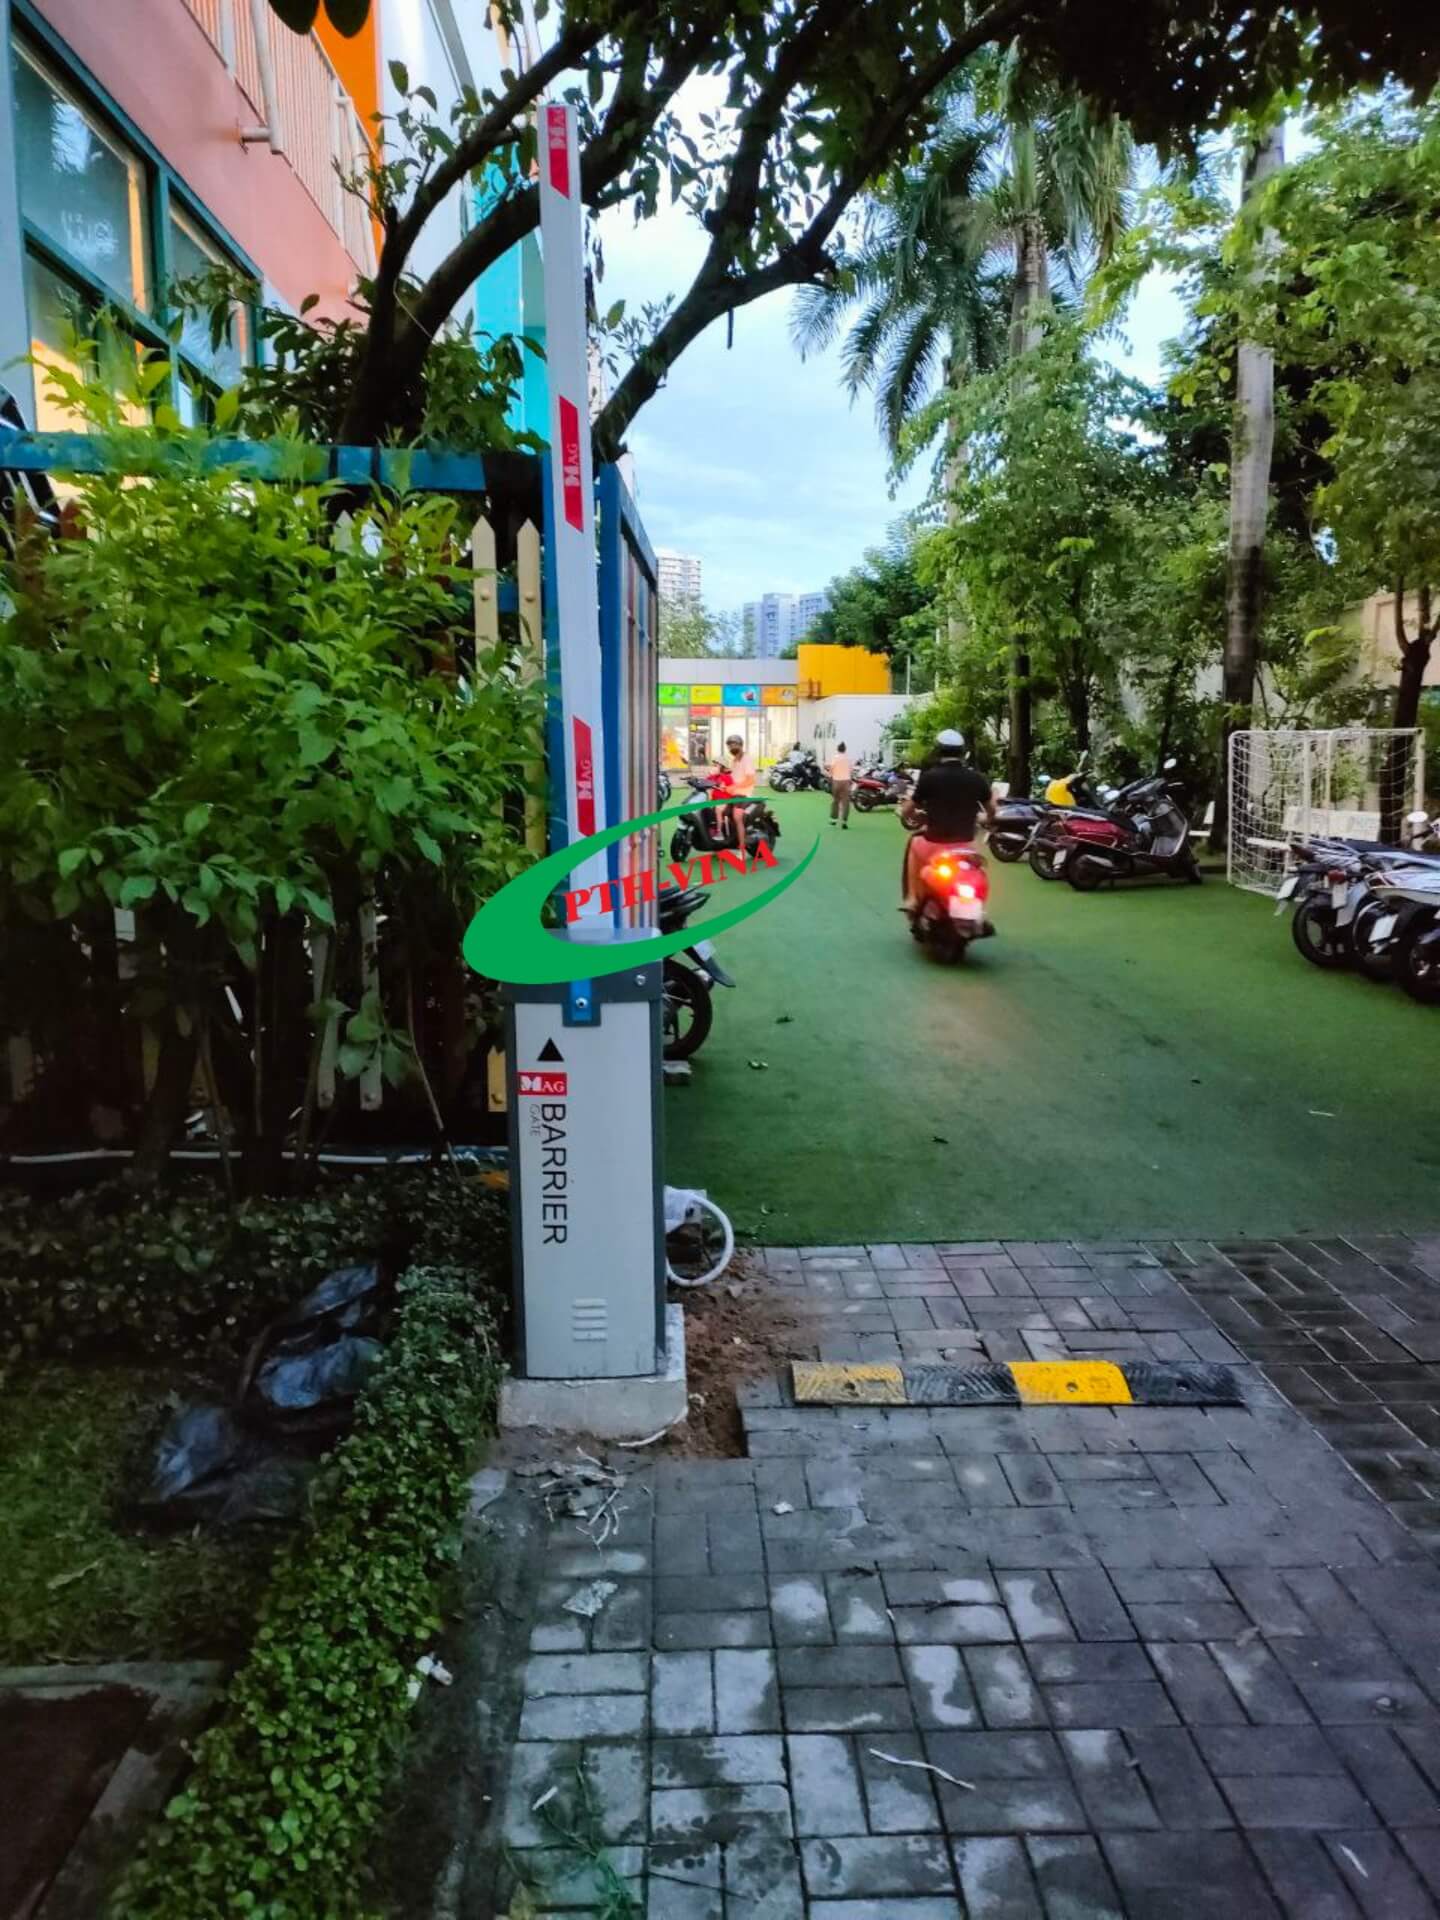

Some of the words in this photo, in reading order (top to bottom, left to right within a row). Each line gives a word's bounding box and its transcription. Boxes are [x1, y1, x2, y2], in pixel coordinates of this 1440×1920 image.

[564, 442, 580, 487] MAG
[577, 758, 592, 800] MAG
[520, 1075, 566, 1092] MAG
[529, 1103, 541, 1137] GATE
[541, 1103, 568, 1245] BARRIER
